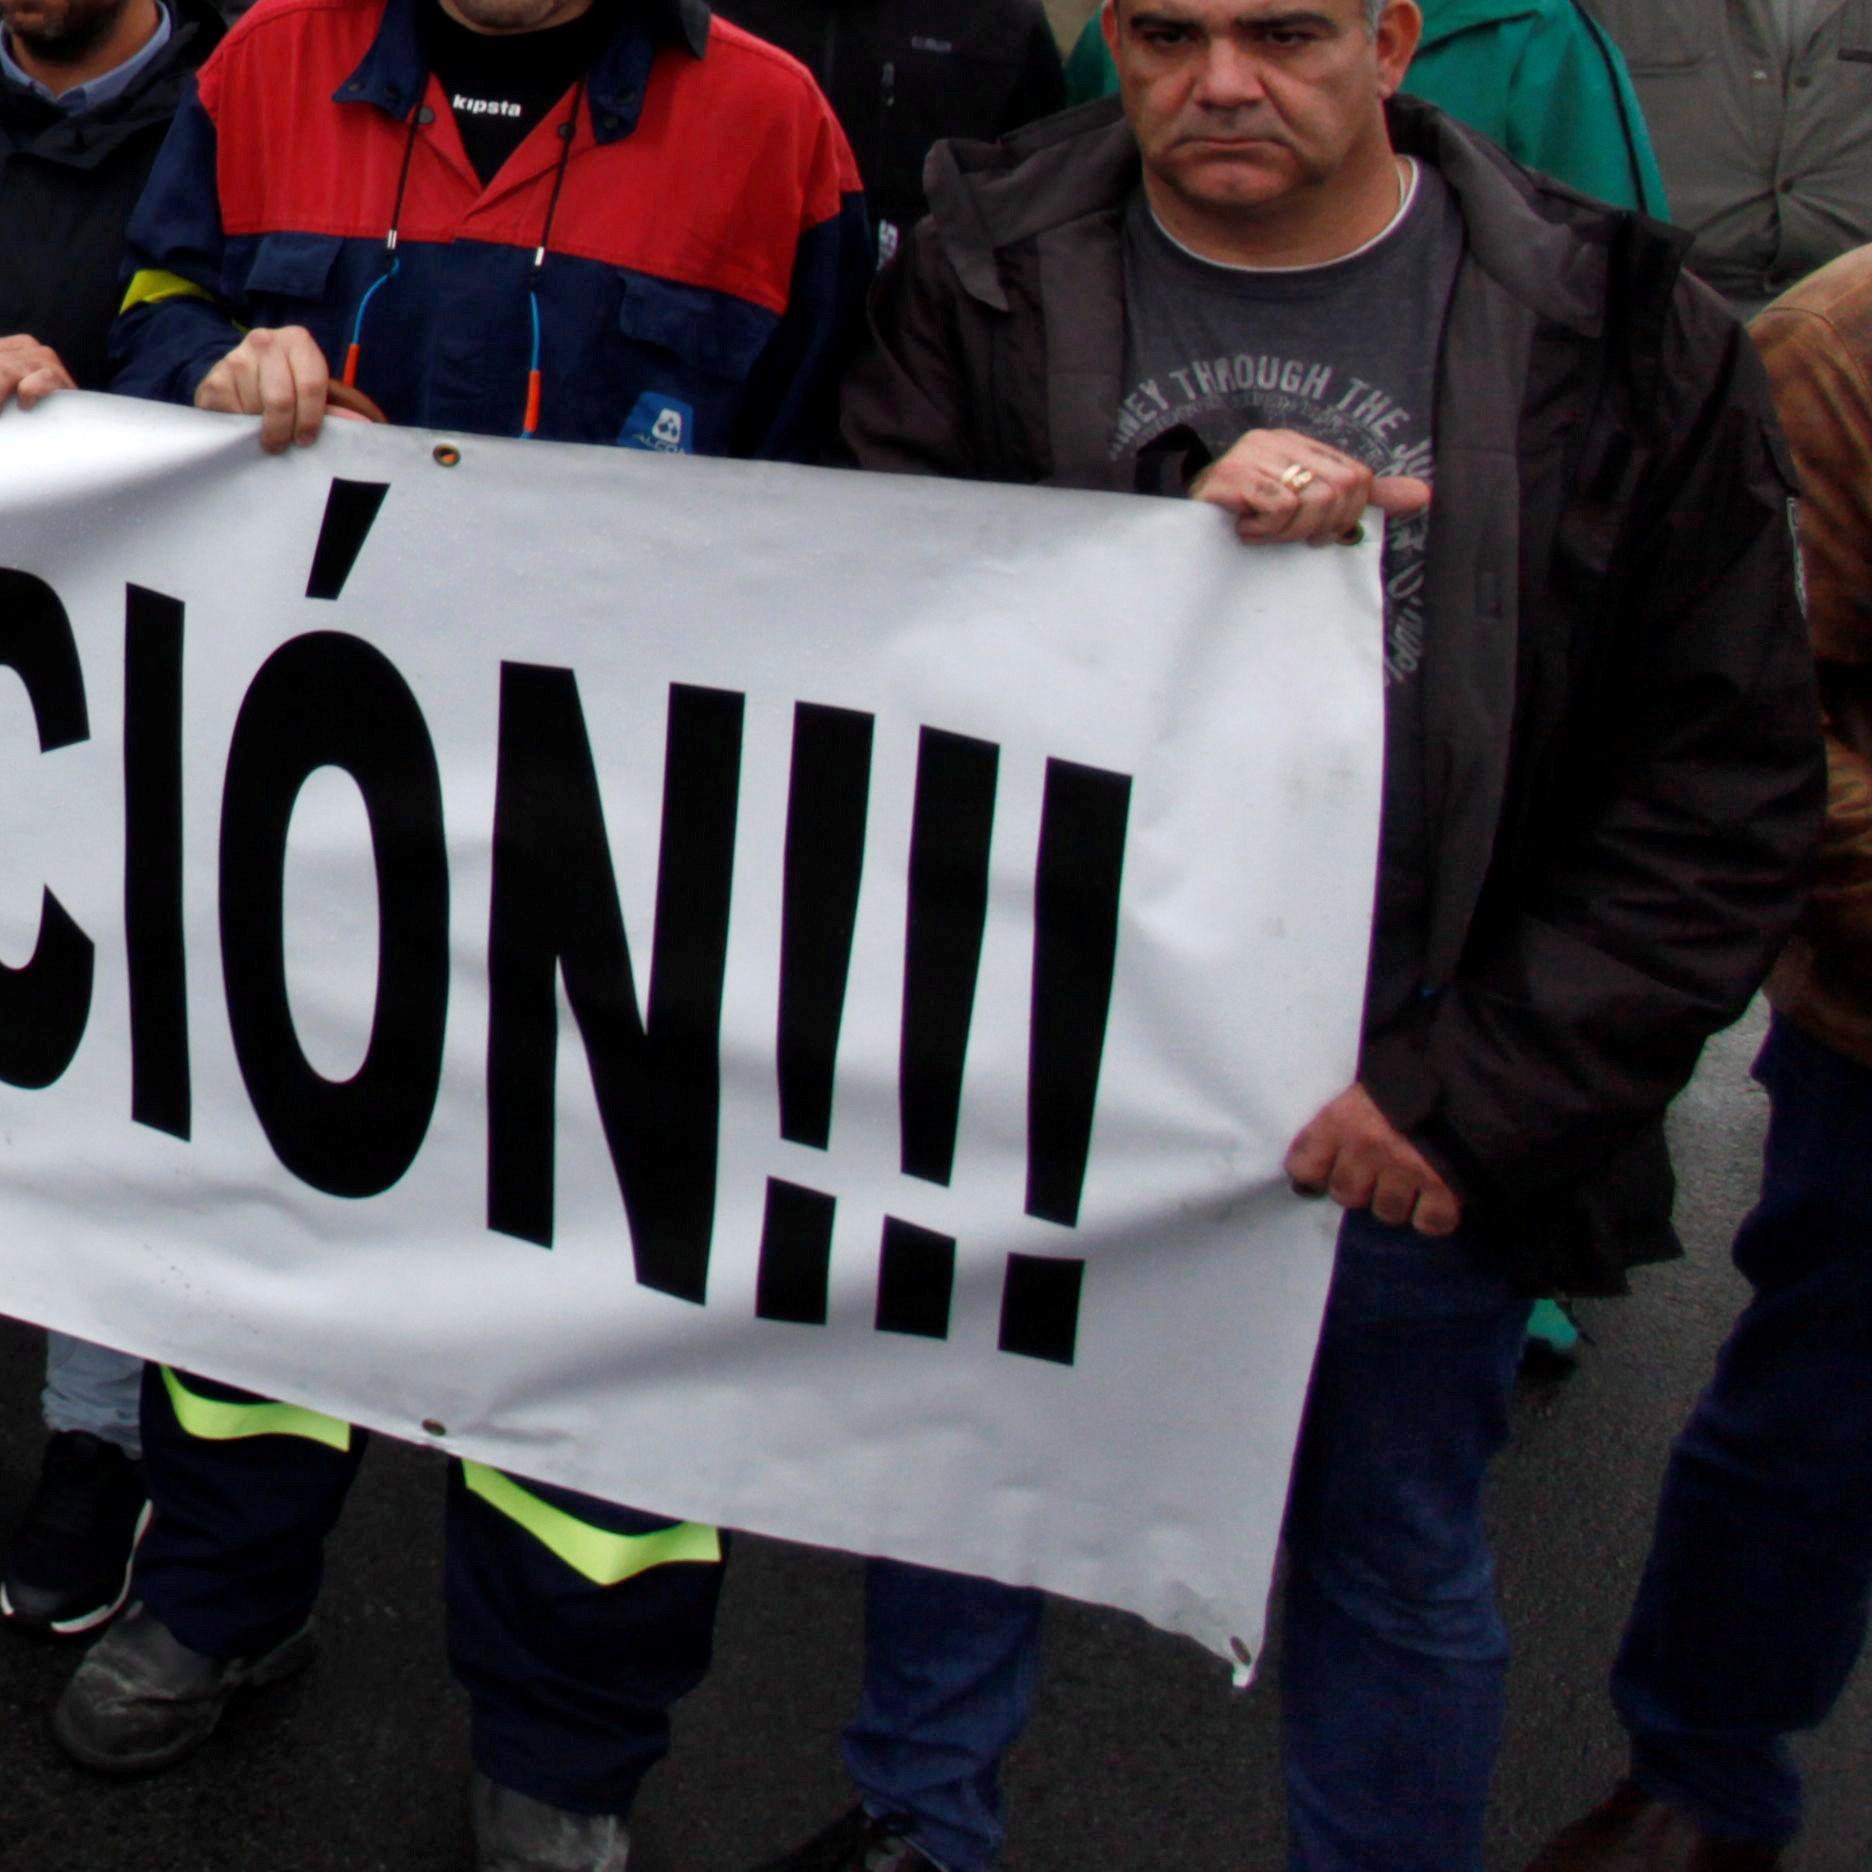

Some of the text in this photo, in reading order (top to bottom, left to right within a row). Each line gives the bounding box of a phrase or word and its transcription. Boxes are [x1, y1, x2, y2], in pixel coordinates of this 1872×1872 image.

[452, 93, 522, 117] kipsta
[1169, 354, 1333, 401] THROUGH
[1337, 376, 1411, 438] THE
